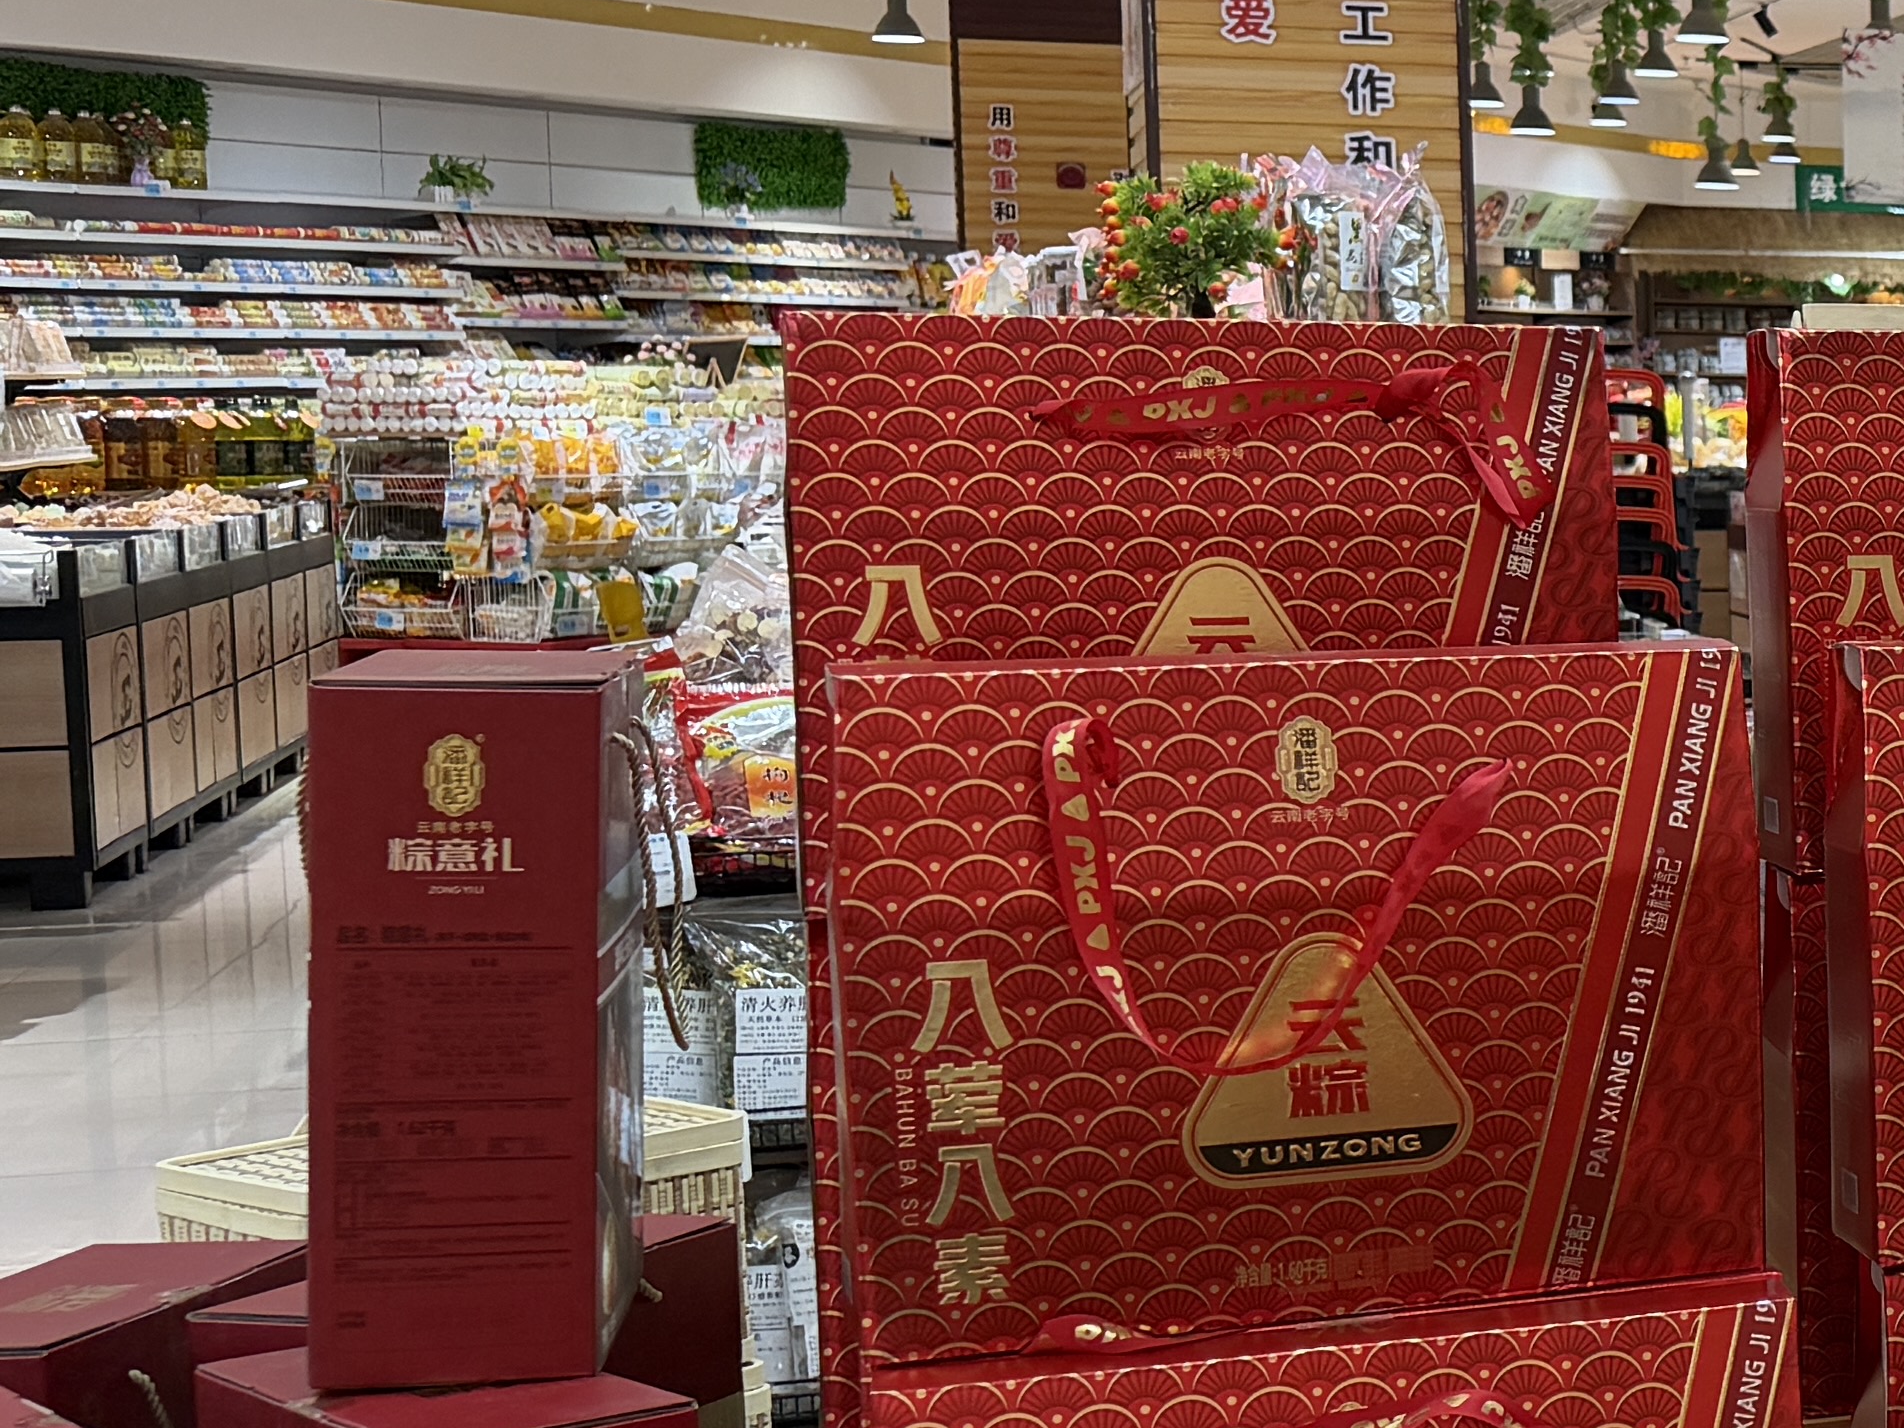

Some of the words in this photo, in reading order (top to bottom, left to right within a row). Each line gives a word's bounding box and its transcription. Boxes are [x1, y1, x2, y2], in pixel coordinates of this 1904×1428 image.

[1270, 808, 1349, 823] 云南老字号
[387, 837, 524, 872] 粽意礼
[911, 958, 1014, 1306] 八荤八素
[1231, 1129, 1423, 1167] YUNZONG
